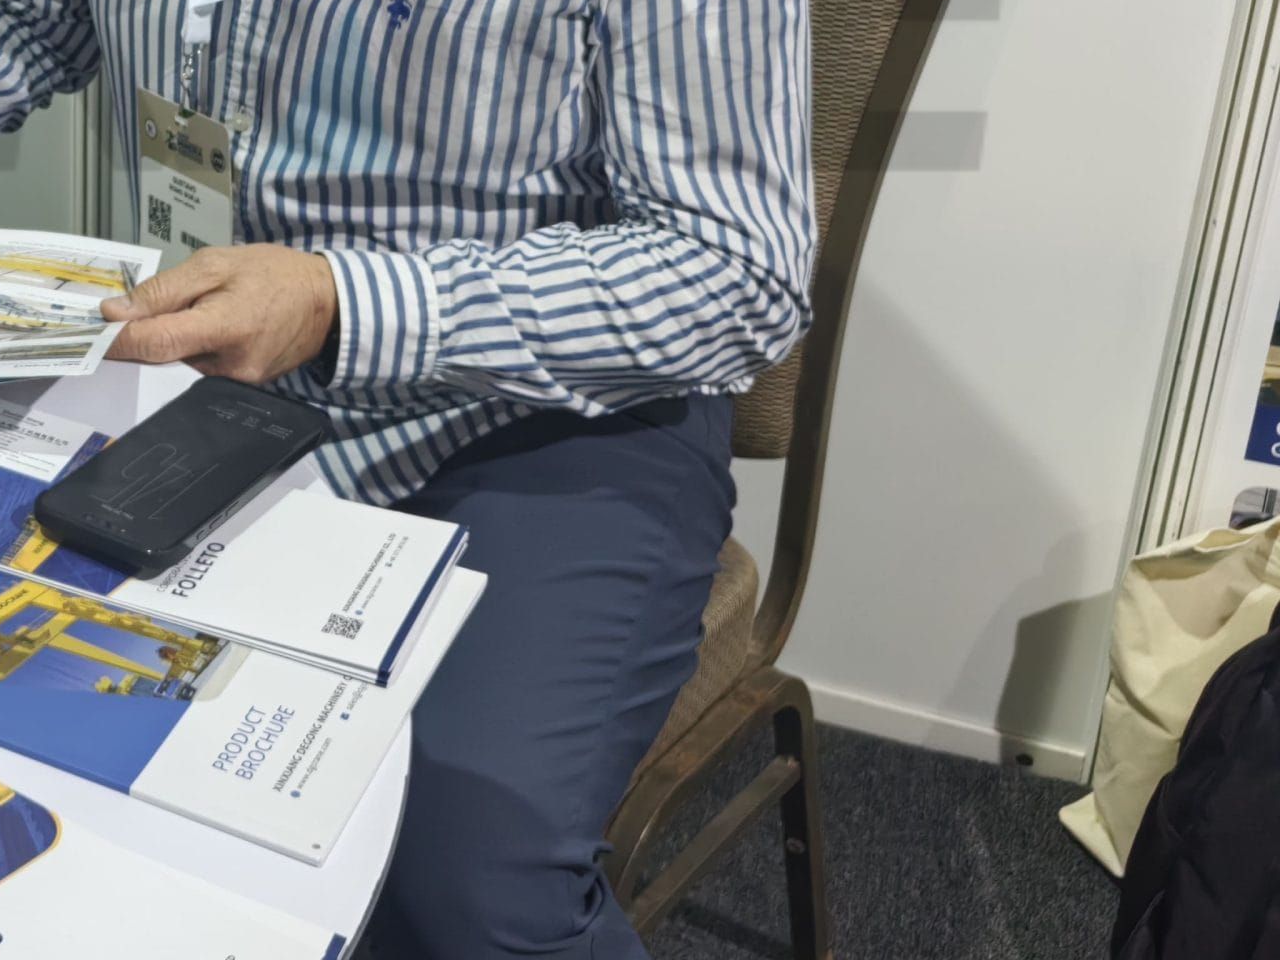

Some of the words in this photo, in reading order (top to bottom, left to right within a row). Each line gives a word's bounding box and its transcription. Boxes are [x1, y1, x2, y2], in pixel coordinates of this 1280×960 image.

[171, 541, 225, 598] FOLLETO
[211, 705, 266, 772] PRODUCT
[235, 704, 295, 780] BROCHURE
[273, 750, 302, 792] XINXIANG
[299, 723, 323, 757] DEGONG
[317, 681, 347, 725] MACHINERY
